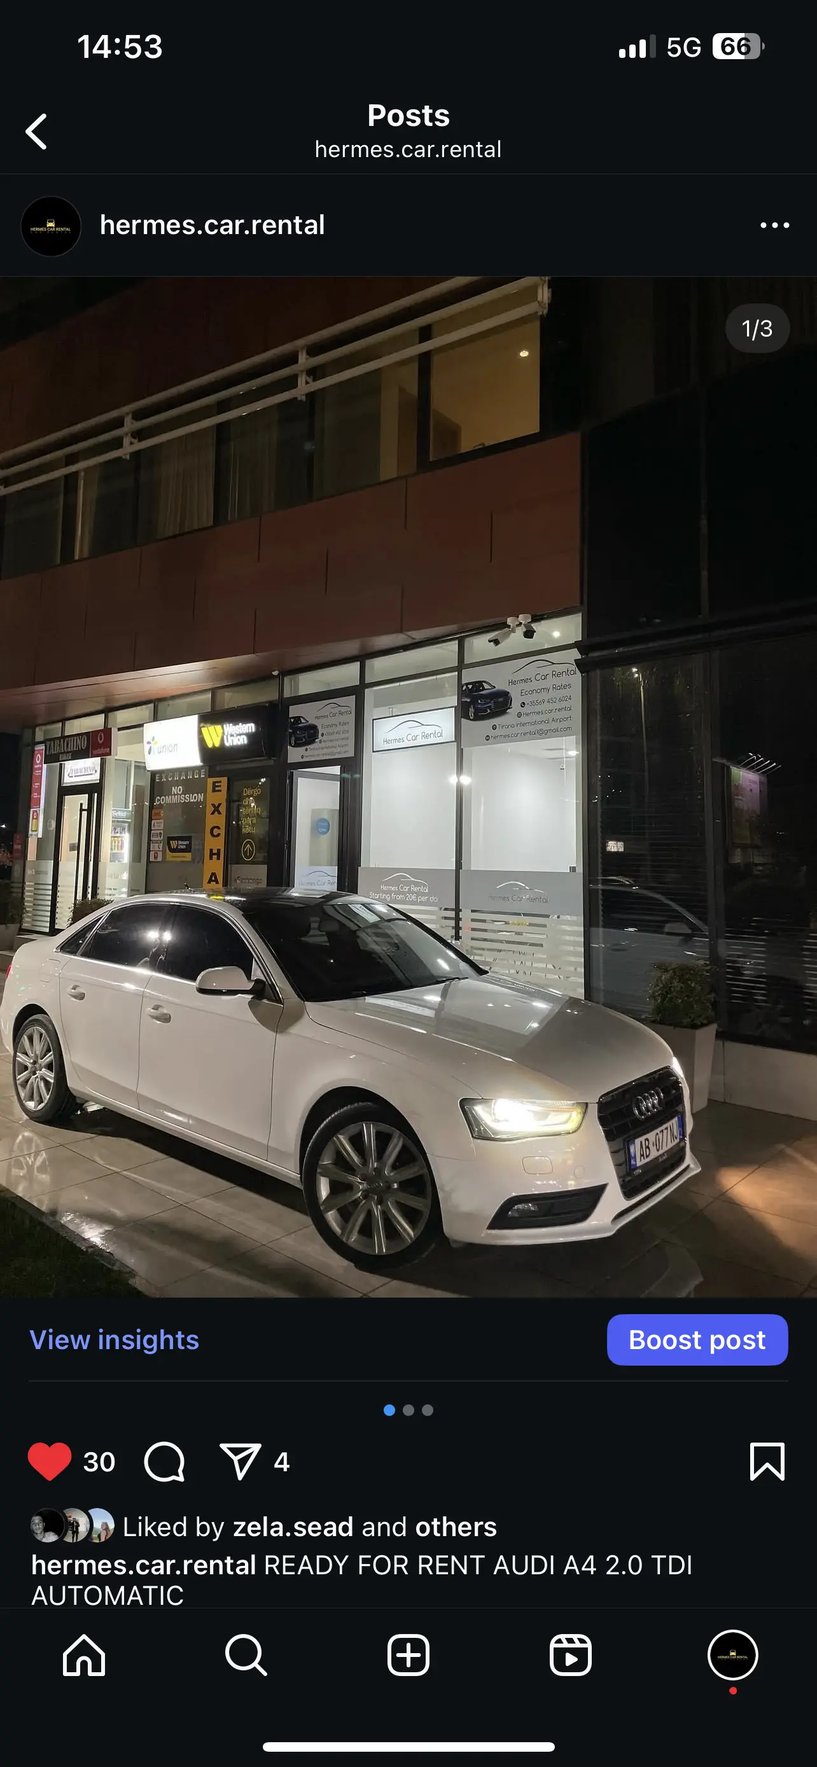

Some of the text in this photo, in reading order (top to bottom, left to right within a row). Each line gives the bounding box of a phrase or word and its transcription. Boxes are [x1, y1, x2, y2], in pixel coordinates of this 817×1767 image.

[534, 672, 550, 682] Car
[551, 667, 577, 679] Rental
[520, 683, 572, 697] Economy Rates
[559, 695, 572, 703] 6024
[223, 722, 256, 734] Western
[223, 733, 248, 747] Union
[382, 728, 444, 745] Hermes Car Rental
[46, 734, 88, 755] TABACHINO
[155, 769, 206, 782] EXCHANGE
[171, 785, 183, 795] NO
[155, 793, 204, 805] COMMISSION
[380, 883, 429, 893] Hermes Car Rental
[369, 891, 390, 900] Starting
[391, 892, 405, 900] from
[639, 1137, 651, 1162] AB
